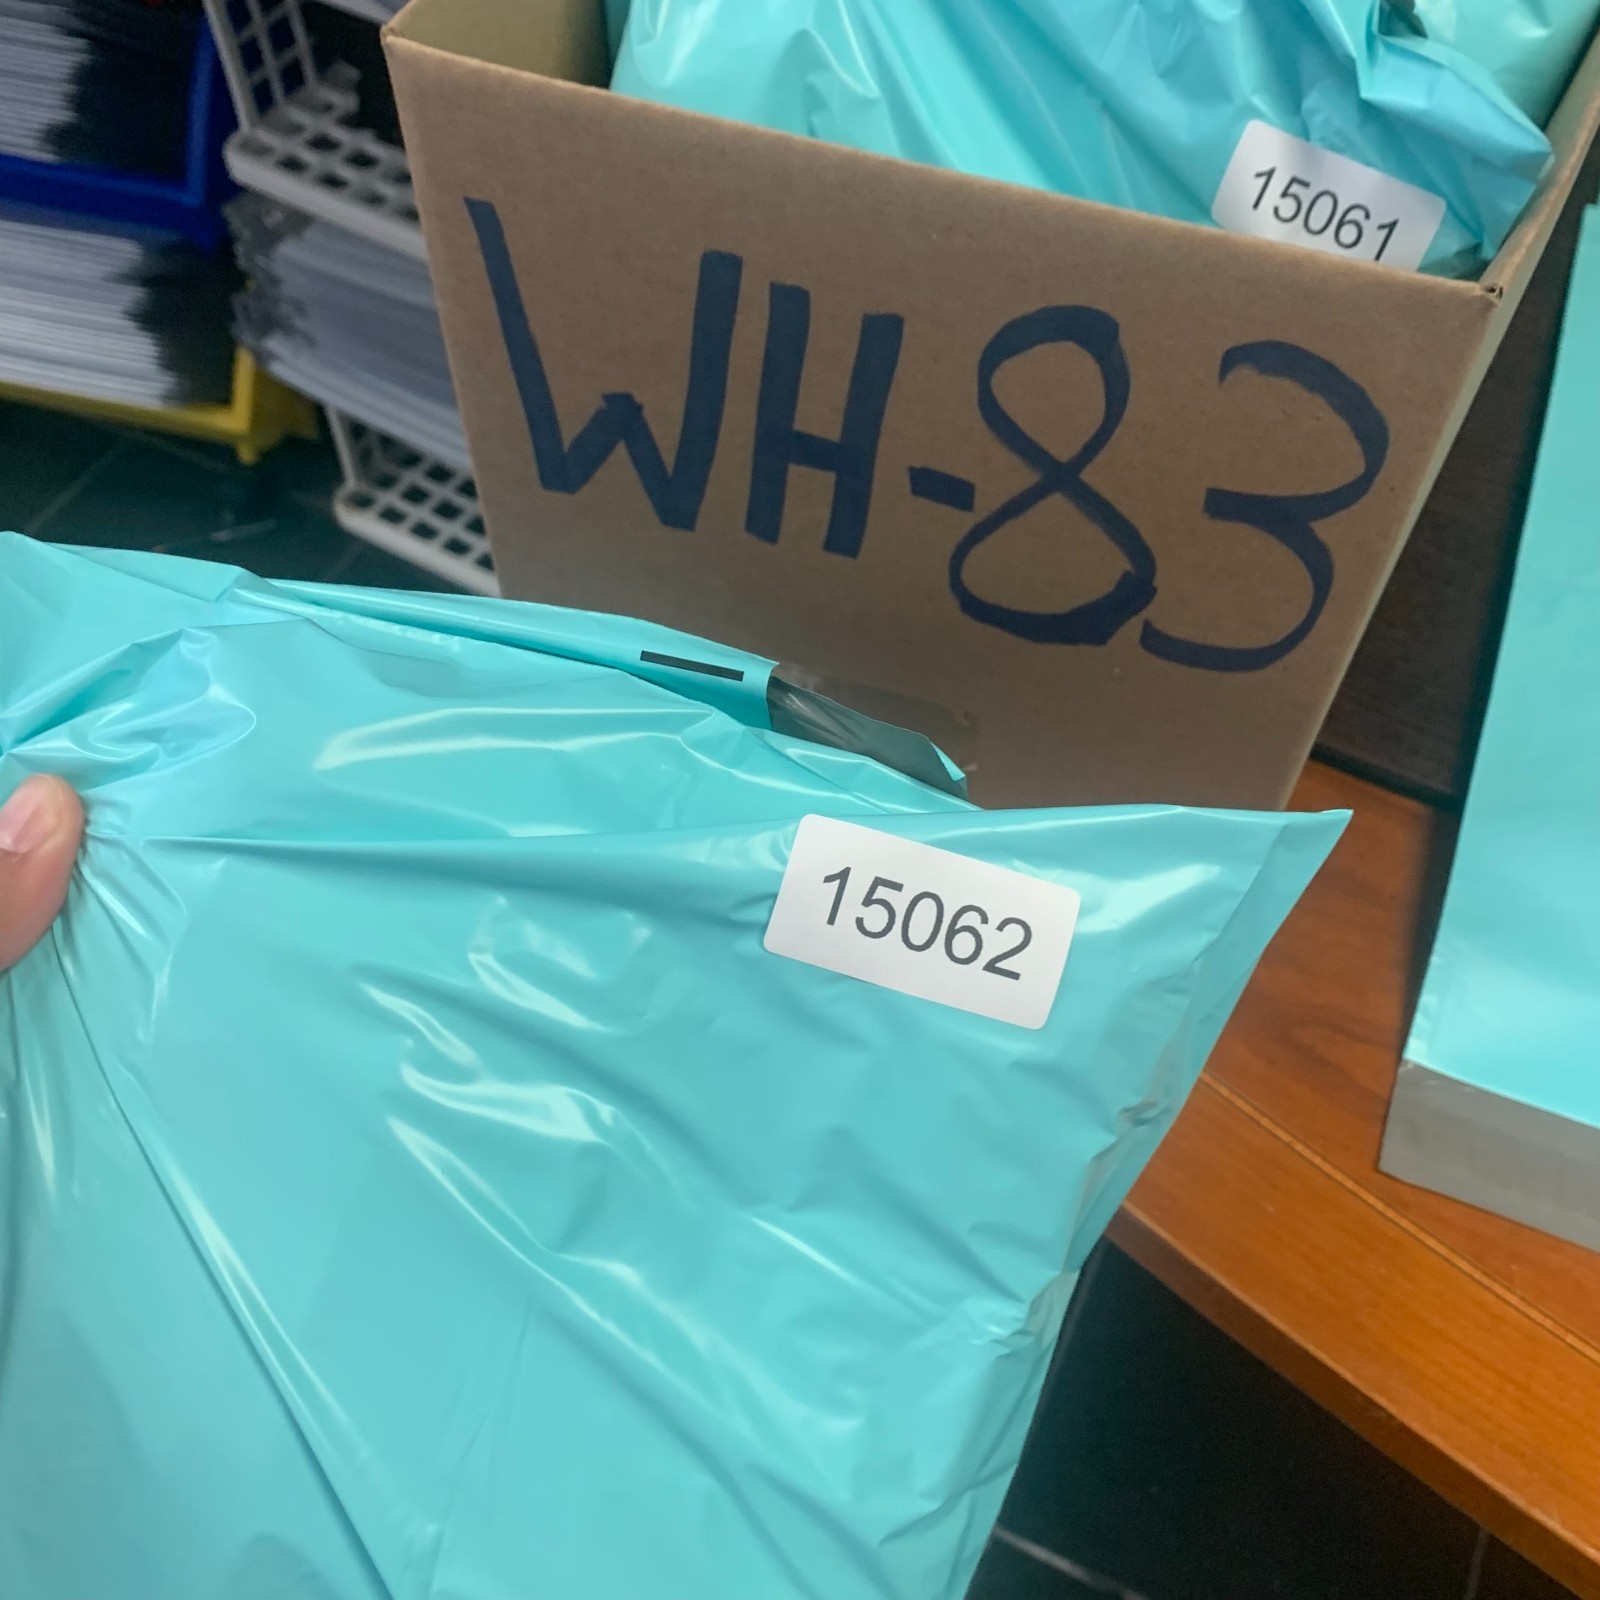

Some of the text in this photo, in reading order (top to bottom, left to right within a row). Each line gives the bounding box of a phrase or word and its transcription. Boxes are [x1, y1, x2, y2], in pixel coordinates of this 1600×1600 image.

[1252, 165, 1400, 263] 15061
[464, 197, 1390, 674] WH-83
[821, 865, 1033, 982] 15062
